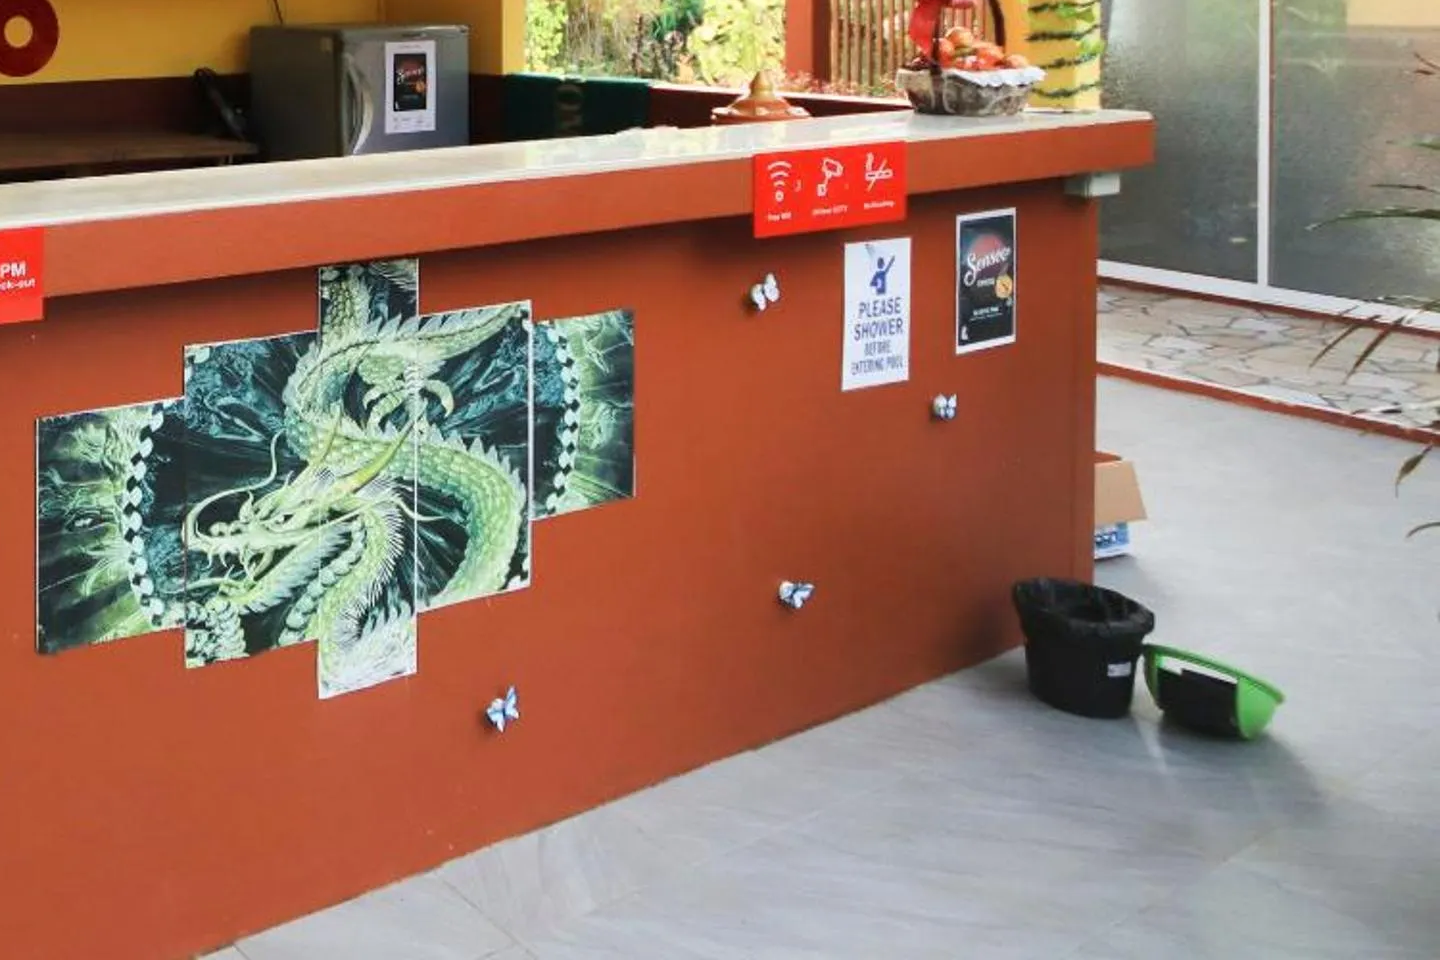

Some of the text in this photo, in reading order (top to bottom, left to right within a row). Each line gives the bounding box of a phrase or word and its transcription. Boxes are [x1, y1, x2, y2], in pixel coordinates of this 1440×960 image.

[0, 261, 26, 278] PM
[859, 297, 901, 319] PLEASE
[854, 318, 903, 341] SHOWER
[863, 340, 892, 356] BEFORE
[851, 358, 884, 375] ENTERING
